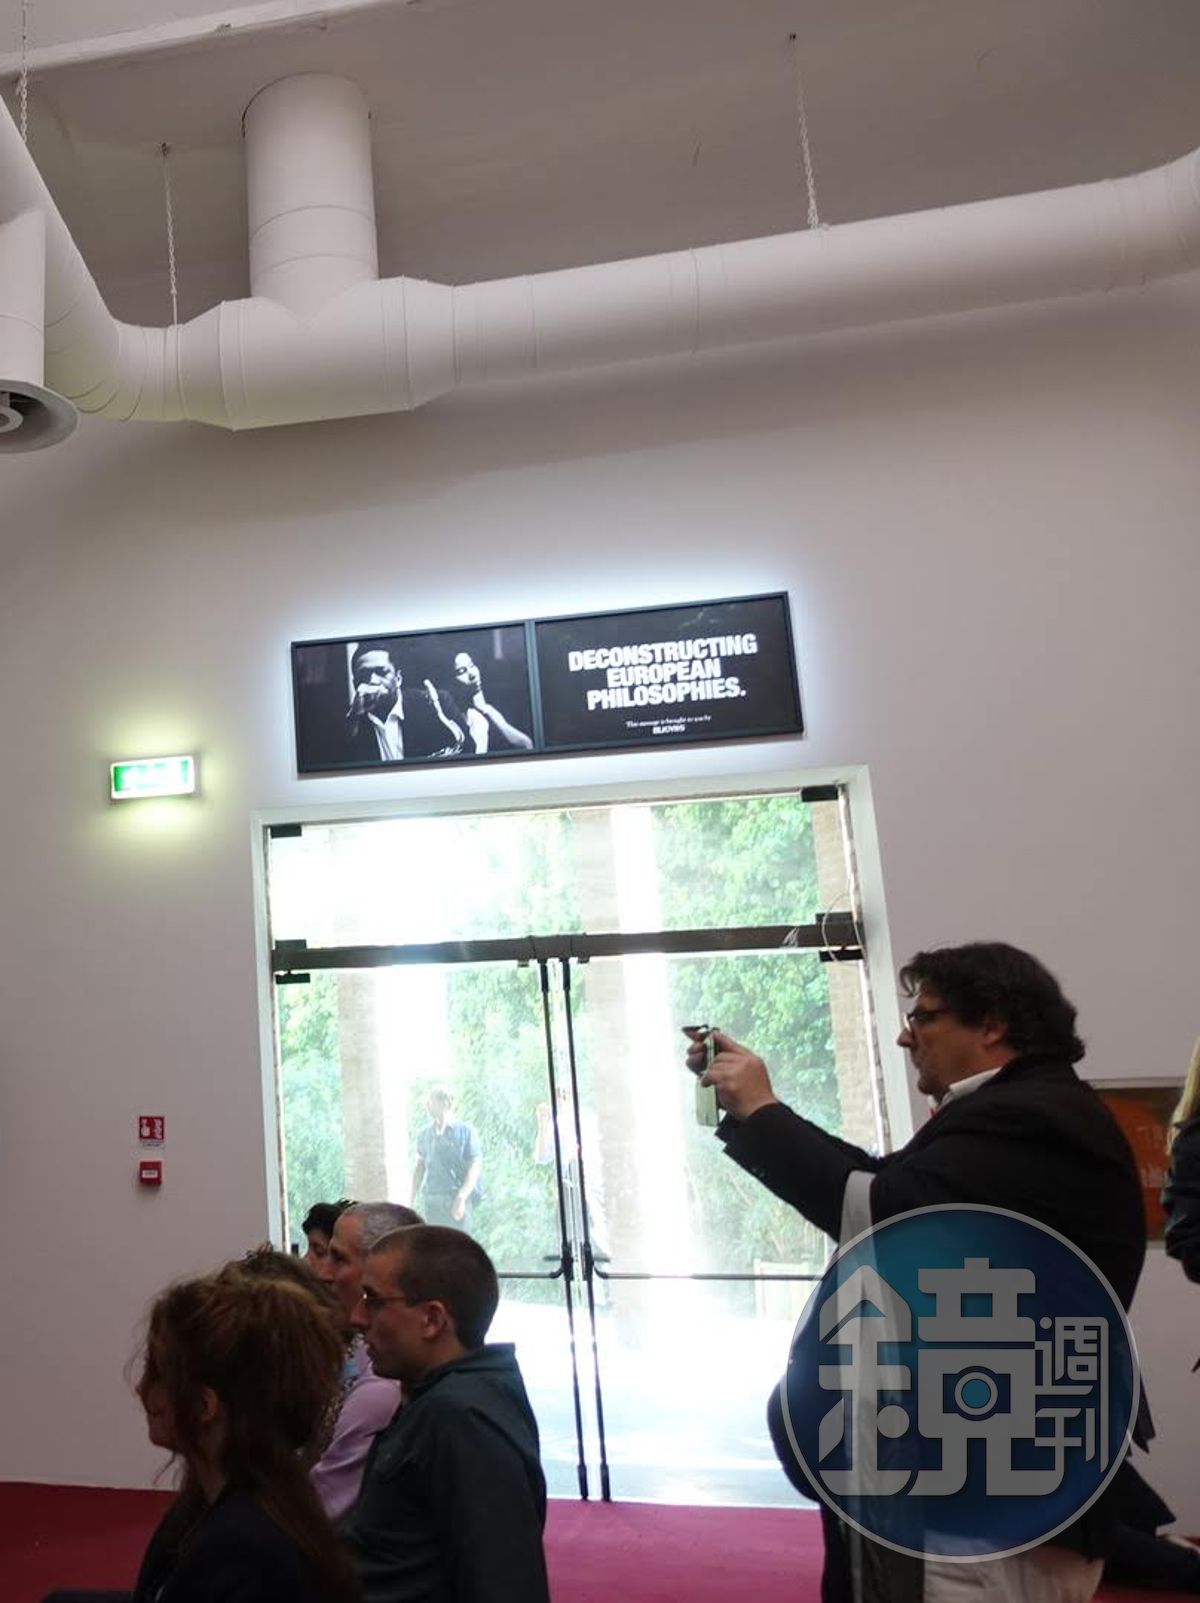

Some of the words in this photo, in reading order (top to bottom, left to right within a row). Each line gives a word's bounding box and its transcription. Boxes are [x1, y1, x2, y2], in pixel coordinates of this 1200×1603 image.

[568, 633, 758, 672] DECONSTRUCTING
[606, 658, 722, 688] EUROPEAN
[586, 676, 747, 711] PHILOSOPHIES.
